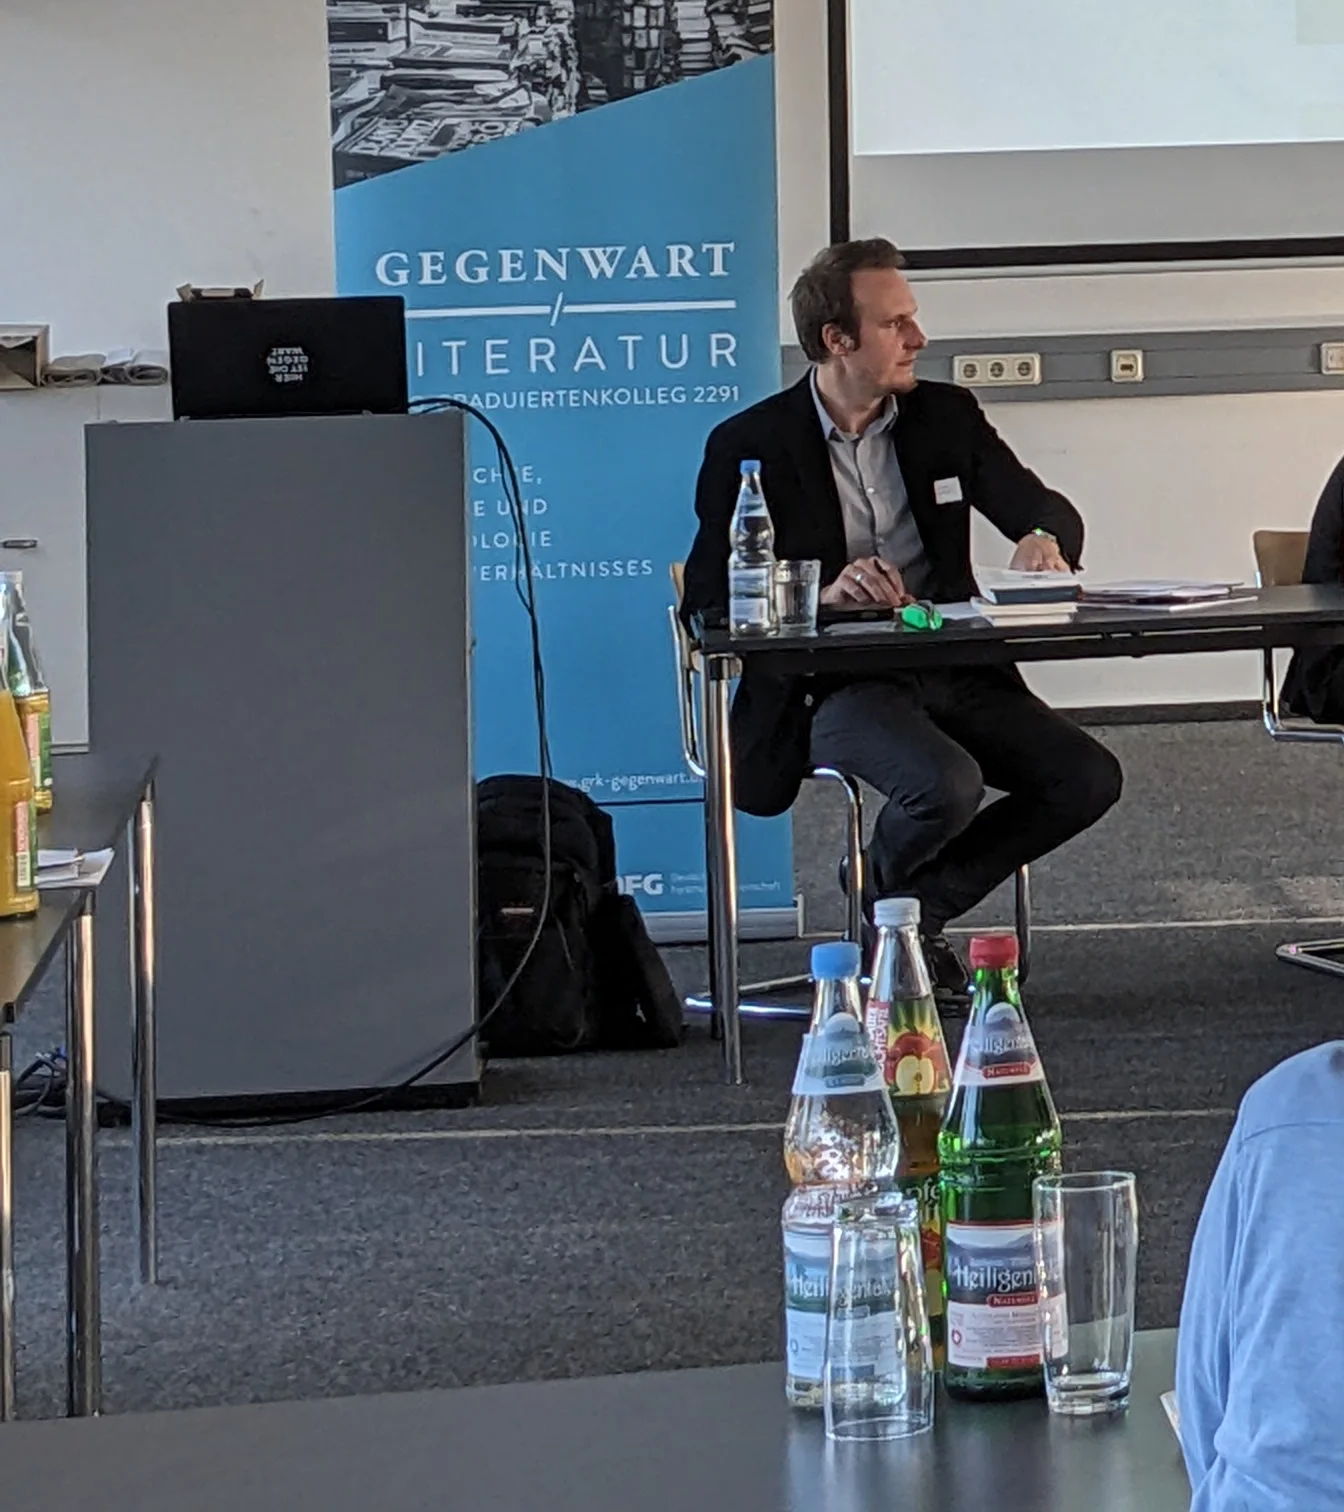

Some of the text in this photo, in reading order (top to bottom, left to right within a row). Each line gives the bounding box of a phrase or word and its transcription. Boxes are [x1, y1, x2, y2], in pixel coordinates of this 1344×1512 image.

[375, 241, 735, 287] GEGENWART
[416, 333, 737, 377] ITERATUR
[693, 385, 739, 403] 2291
